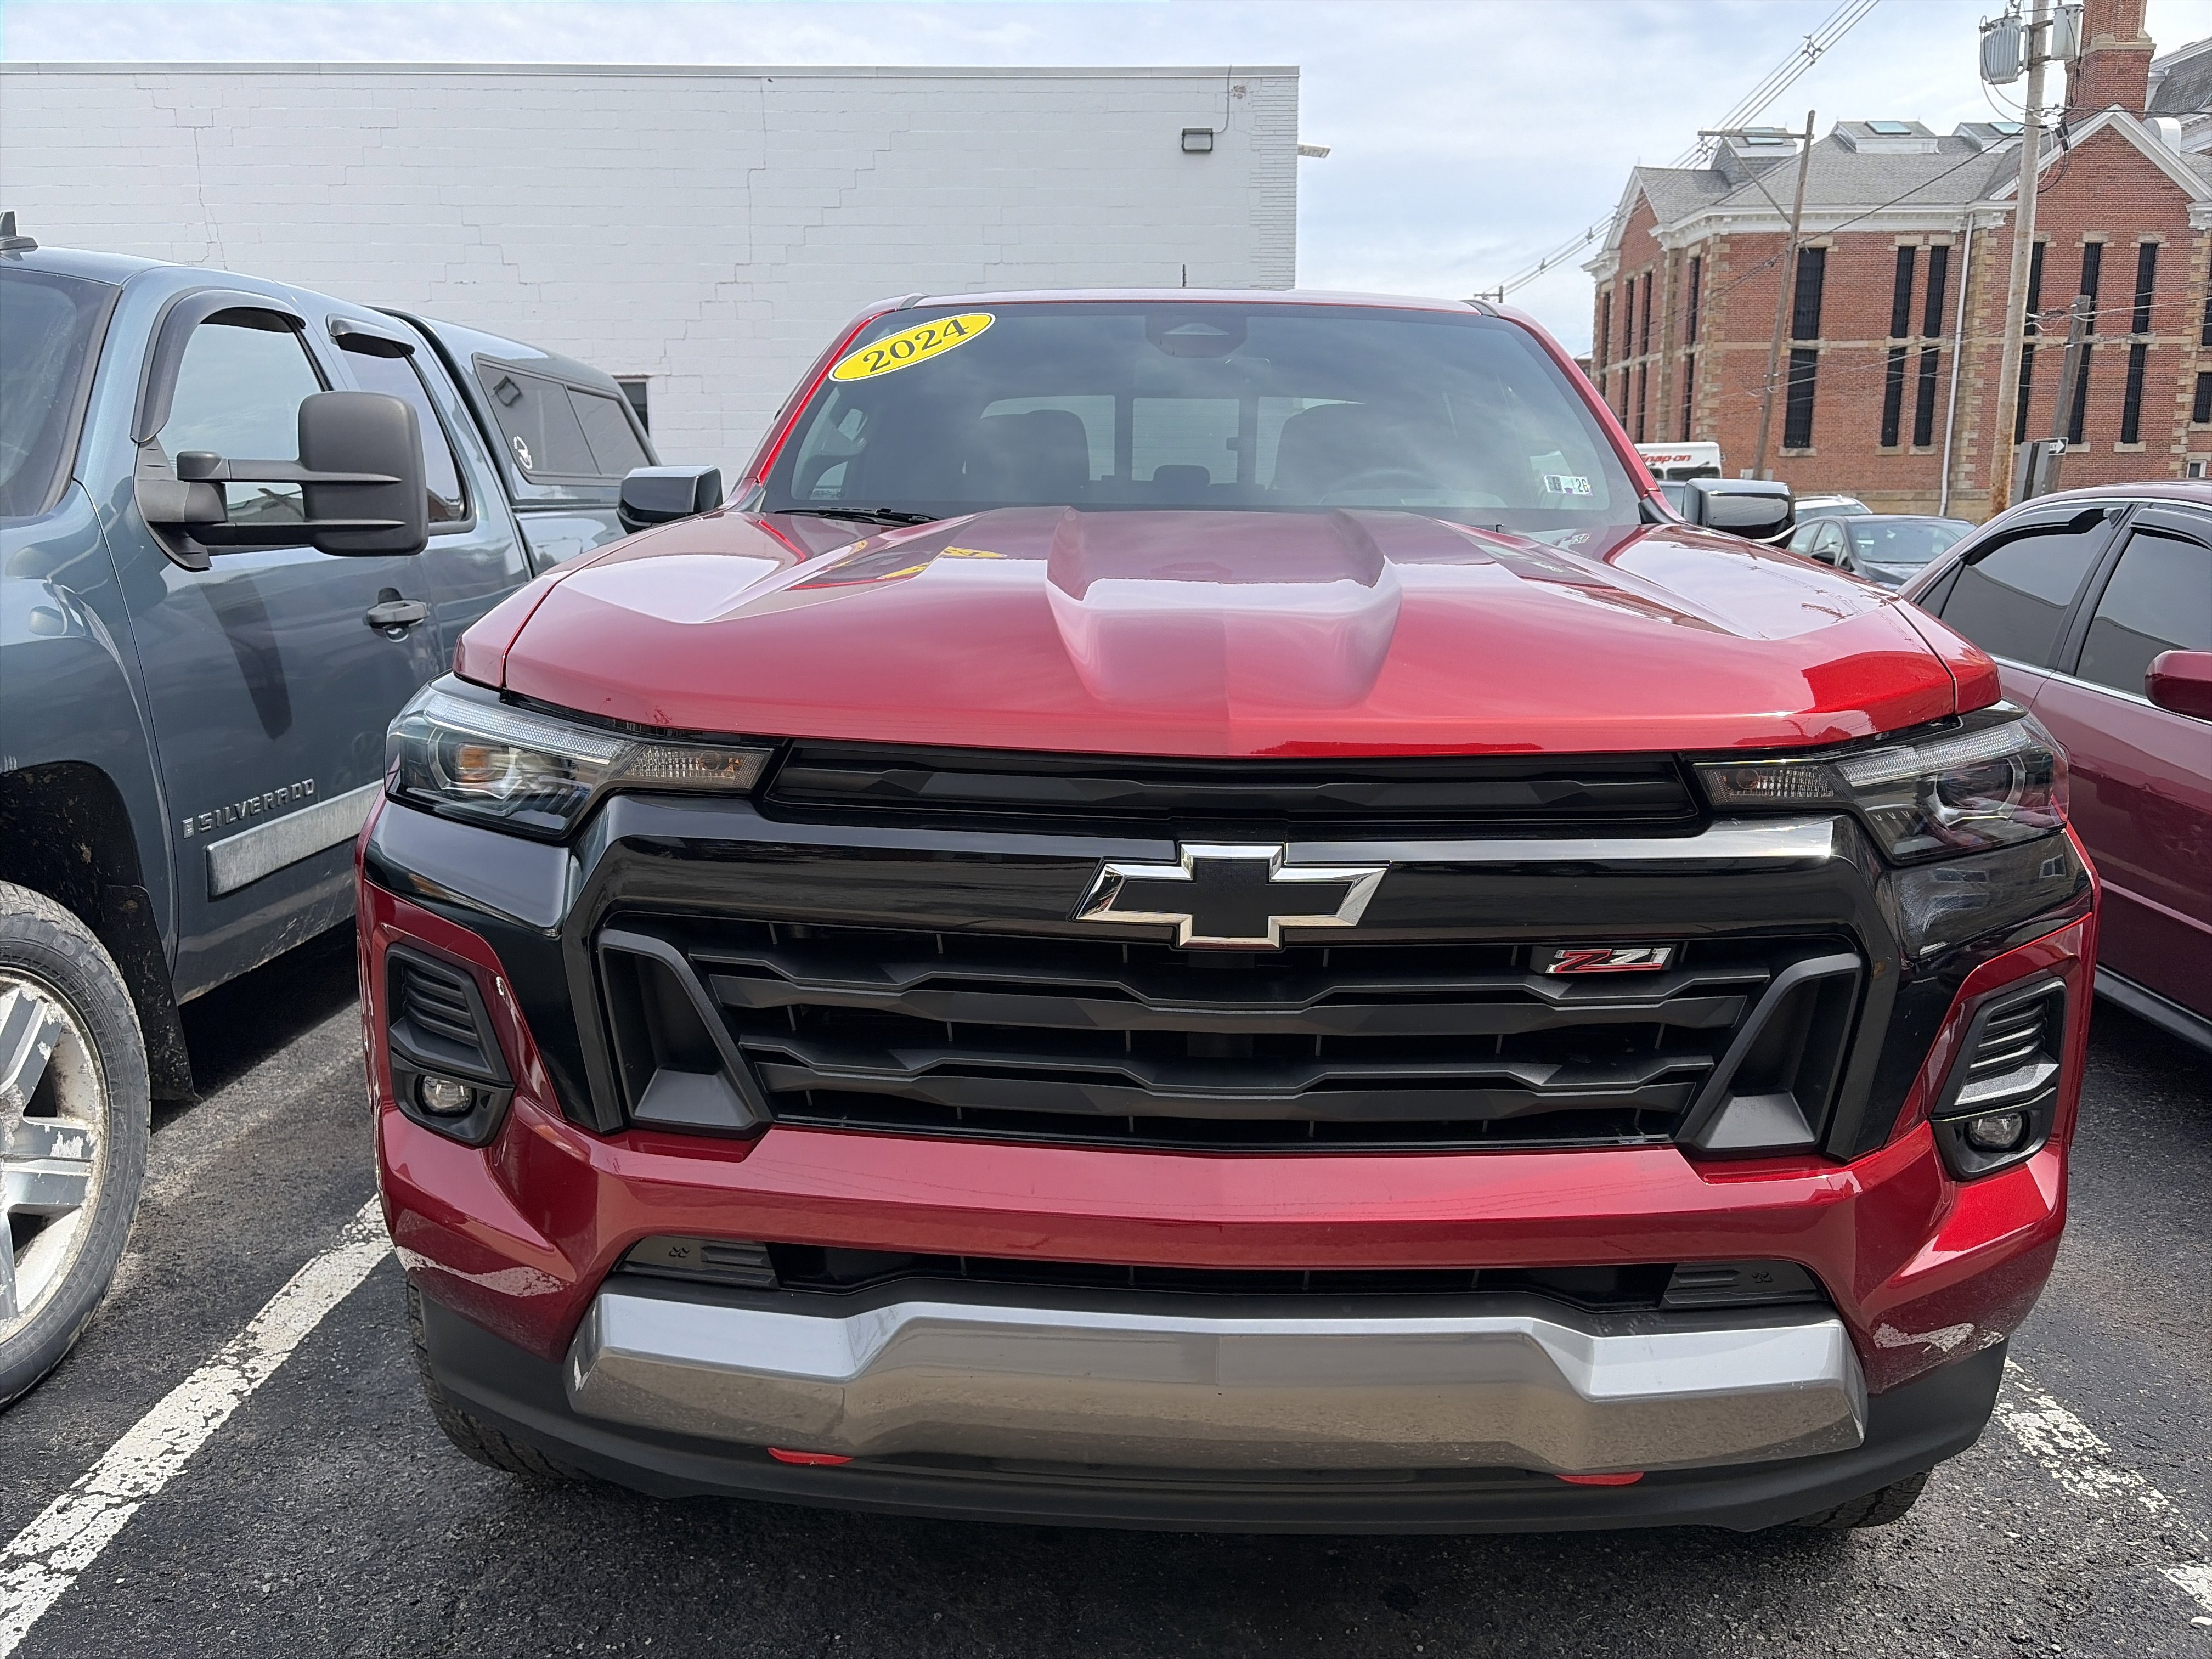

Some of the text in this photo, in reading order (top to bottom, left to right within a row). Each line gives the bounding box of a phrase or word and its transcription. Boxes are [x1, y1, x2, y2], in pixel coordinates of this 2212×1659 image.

[862, 319, 969, 373] 2024
[1576, 478, 1589, 492] 26
[198, 778, 315, 833] SILVERADO
[1545, 947, 1672, 973] Z71
